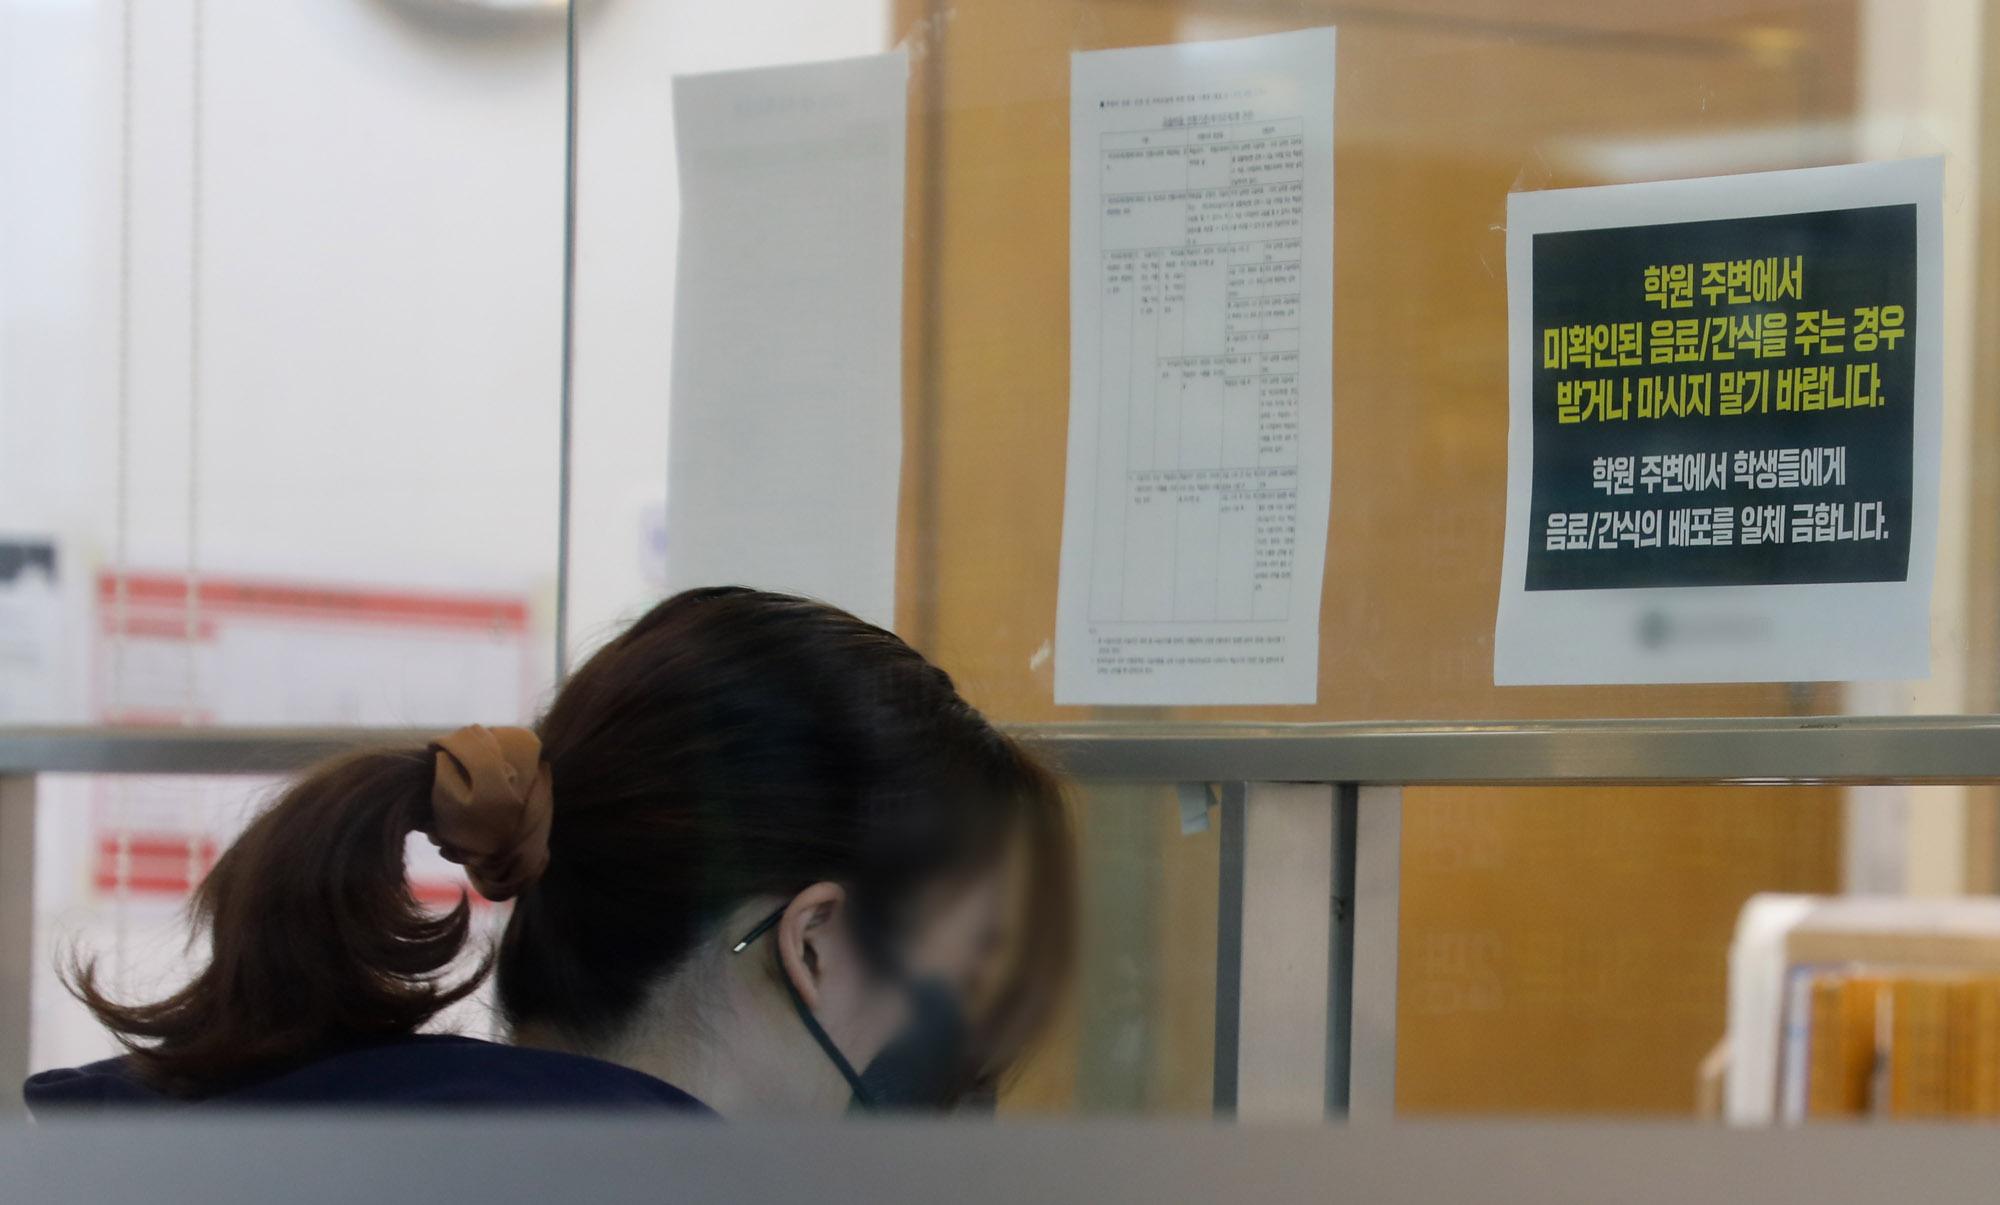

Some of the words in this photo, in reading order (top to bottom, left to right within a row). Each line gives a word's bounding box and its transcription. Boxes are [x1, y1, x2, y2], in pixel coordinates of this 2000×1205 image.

[1645, 264, 1693, 309] 학원
[1701, 256, 1802, 305] 주변에서
[1544, 322, 1642, 369] 미확인된
[1650, 313, 1787, 364] 음료/간식을
[1795, 310, 1845, 355] 주는
[1854, 305, 1904, 351] 경우
[1558, 378, 1631, 423] 받거나
[1638, 373, 1711, 418] 마시지
[1720, 370, 1769, 415] 말기
[1777, 363, 1884, 411] 바랍니다.
[1593, 456, 1634, 495] 학원
[1640, 452, 1727, 493] 주변에서
[1734, 447, 1845, 489] 학생들에게
[1547, 510, 1662, 550] 음료/간식의
[1669, 507, 1733, 546] 배포를
[1742, 505, 1785, 544] 일체
[1792, 502, 1888, 542] 금합니다.
